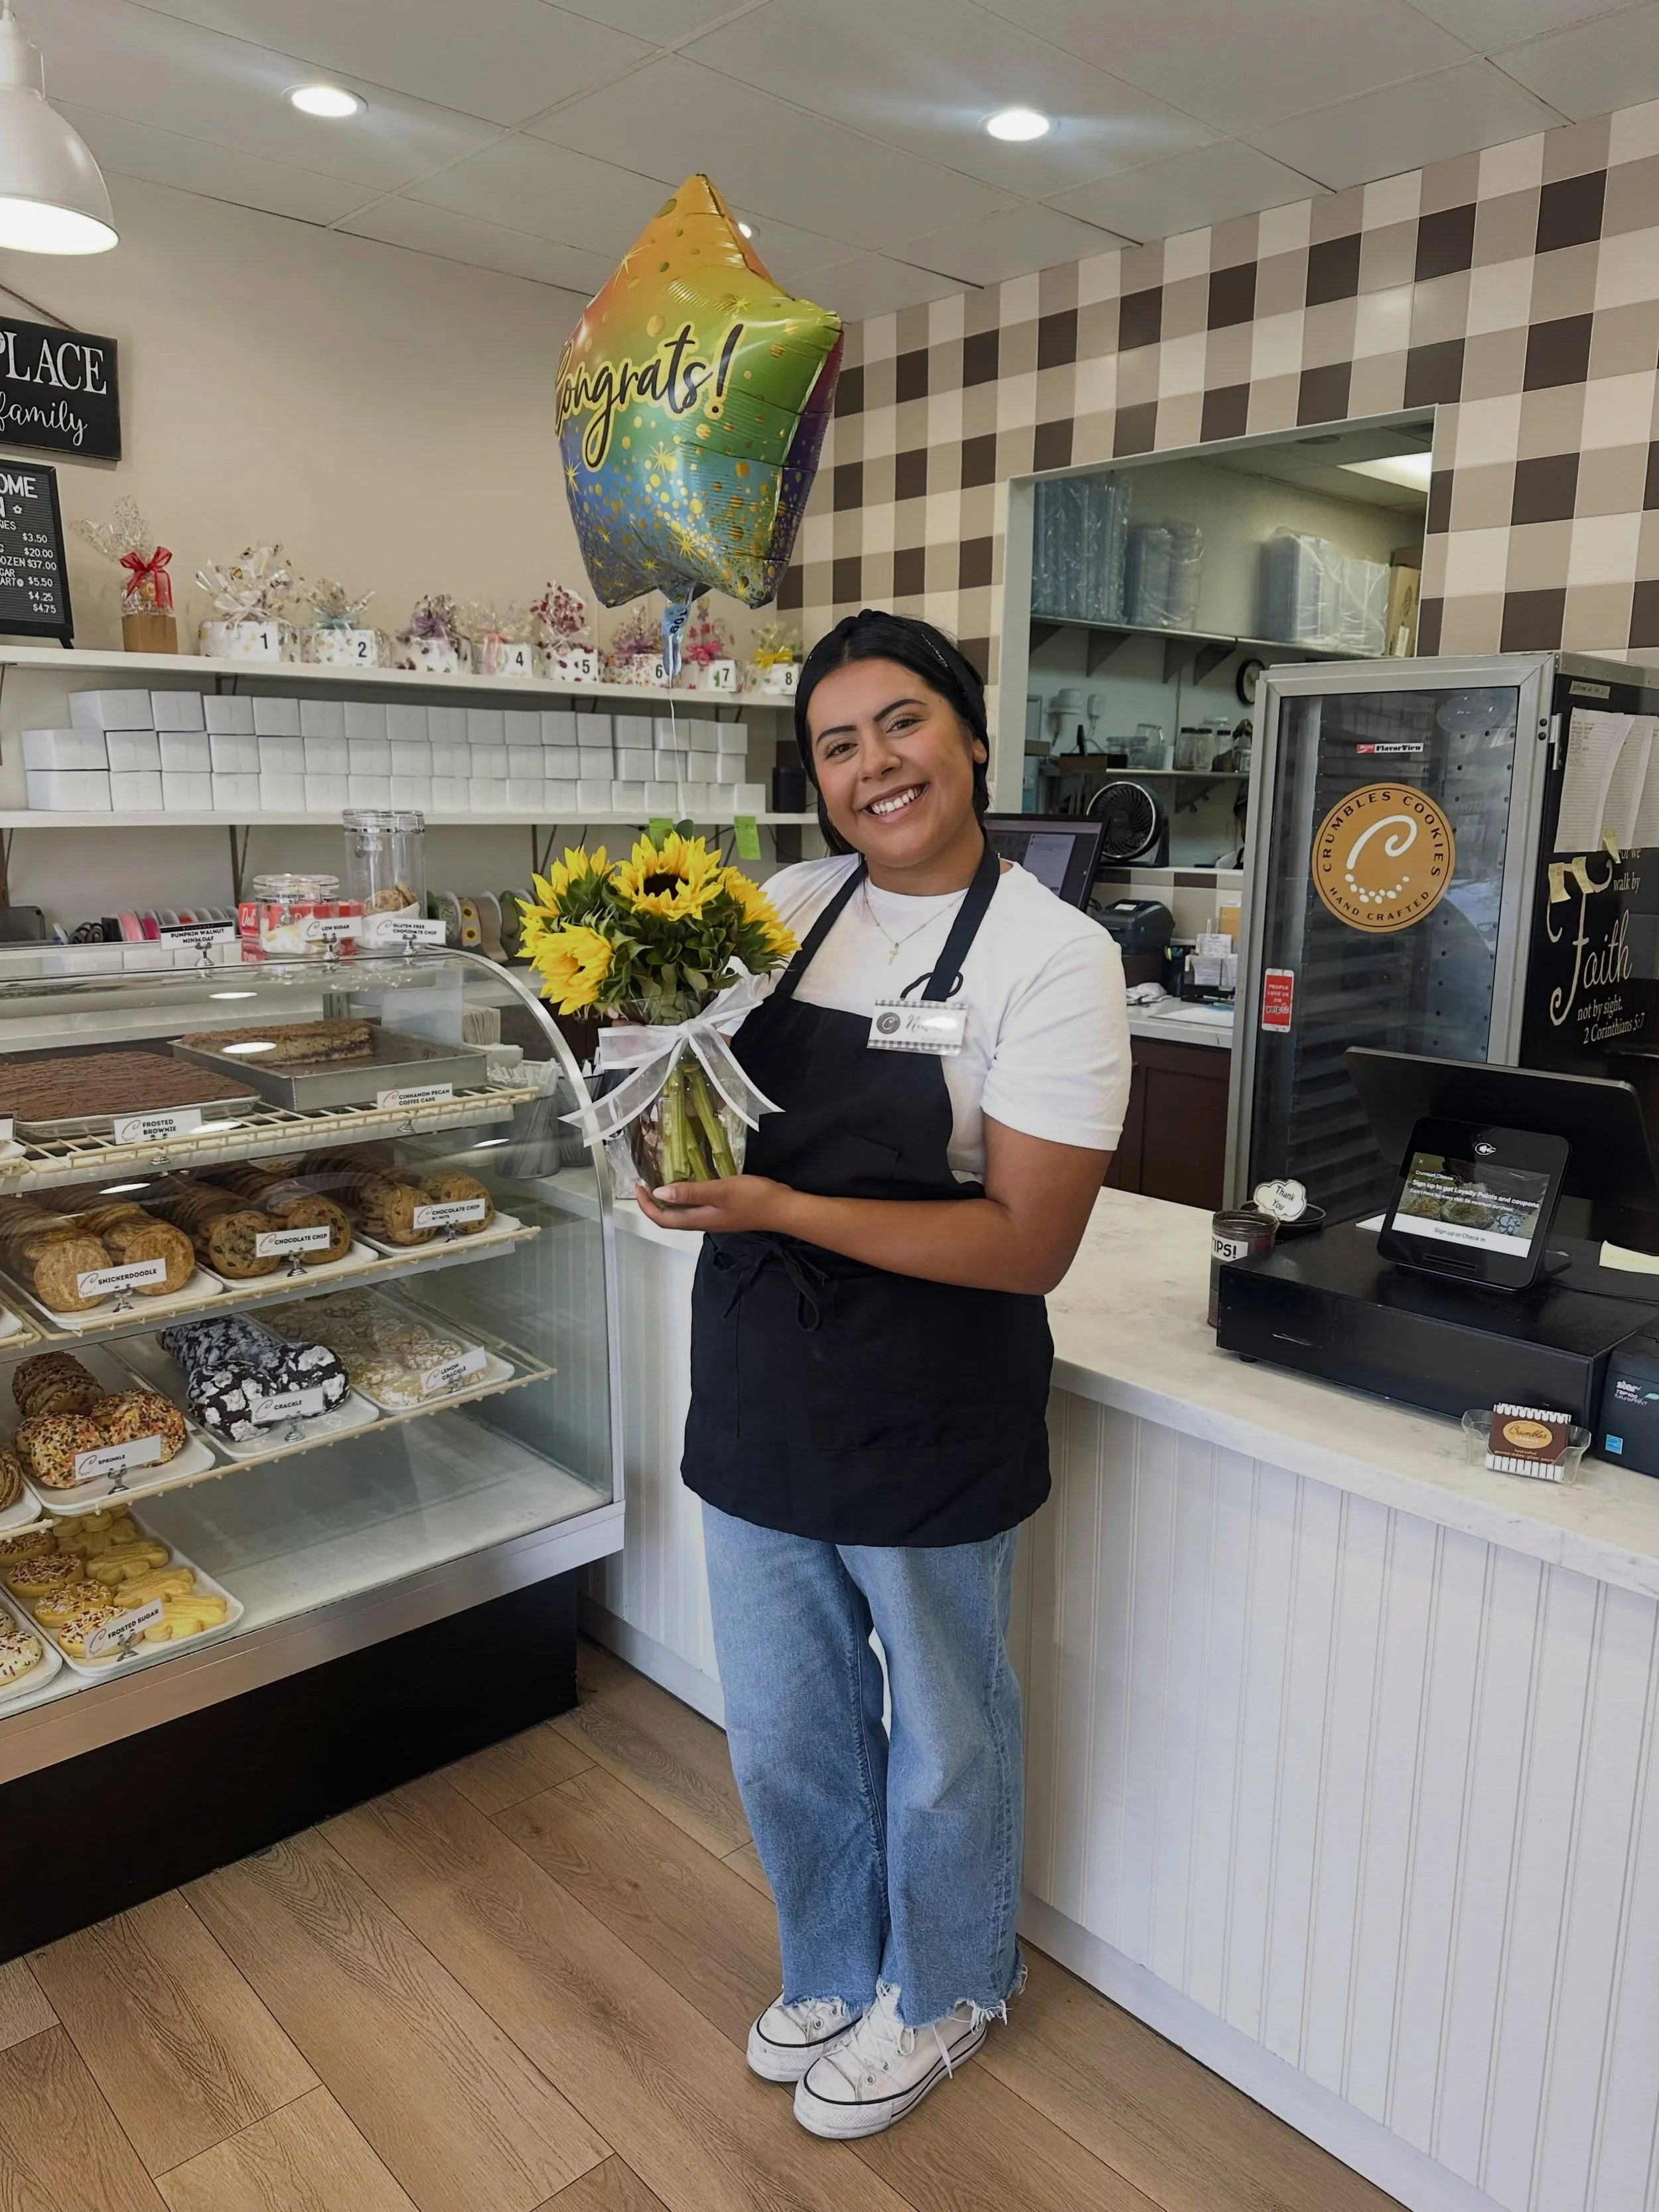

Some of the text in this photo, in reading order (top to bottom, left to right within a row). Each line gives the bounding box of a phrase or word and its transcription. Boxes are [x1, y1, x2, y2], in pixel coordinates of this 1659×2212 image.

[23, 532, 48, 543] $3.50
[24, 547, 54, 558] $20.00
[27, 559, 57, 571] $37.00
[28, 576, 53, 587] $5.50
[29, 591, 54, 601] $4.25
[33, 603, 57, 614] $4.75
[259, 633, 268, 650] 1
[358, 641, 367, 658] 2
[516, 651, 524, 667] 4
[582, 660, 591, 674] 5
[655, 664, 663, 678] 6
[722, 668, 730, 682] 7
[785, 672, 792, 686] 8
[1323, 791, 1444, 877] CRUMBLES COOKIES
[1613, 871, 1641, 895] walk by
[1329, 887, 1429, 921] HAND CRAFTED
[1577, 994, 1623, 1021] not by sight.
[1583, 1012, 1645, 1045] 2 Corinthians 5:7
[399, 1091, 431, 1100] CINNAMON
[143, 1119, 174, 1128] FROSTED
[143, 1126, 177, 1135] BROWNIE
[1275, 1185, 1296, 1202] Thank
[1411, 1179, 1427, 1188] Sign
[1454, 1187, 1477, 1197] Loyalty
[1477, 1191, 1498, 1201] Points
[1511, 1199, 1540, 1209] coupons
[432, 1206, 466, 1215] CHOCOLATE
[1271, 1199, 1285, 1211] You
[274, 1235, 311, 1245] CHOCOLATE
[98, 1268, 158, 1285] SNICKERDOODLE
[441, 1363, 459, 1374] LEMON
[274, 1400, 303, 1410] CRACKLE
[1508, 1425, 1547, 1439] Crumbles
[98, 1454, 126, 1465] SPRINKLE
[108, 1608, 159, 1639] FROSTED SUGAR
